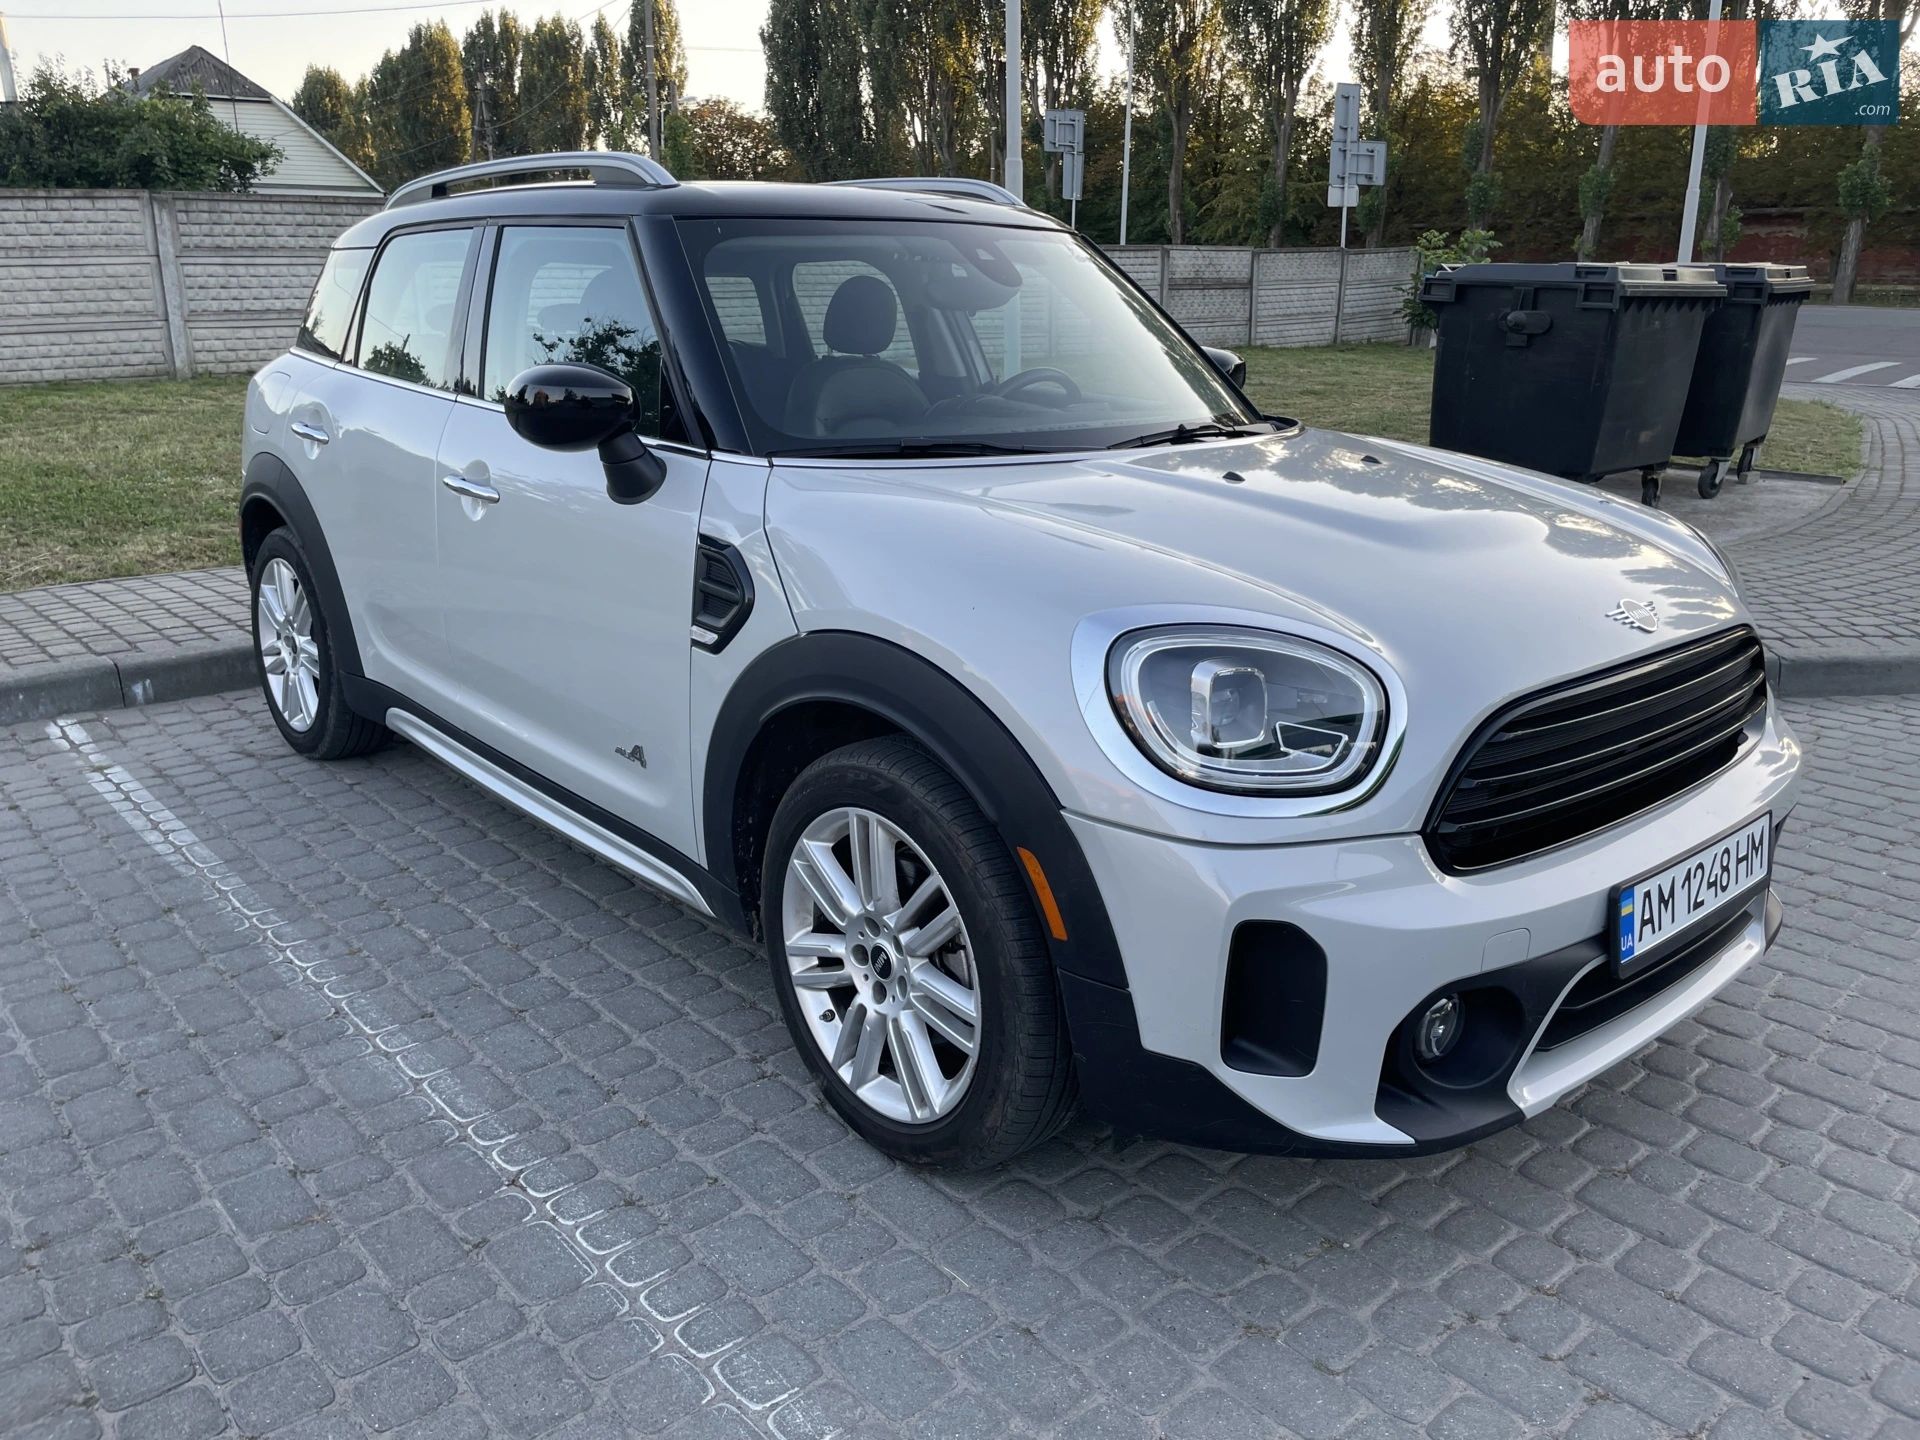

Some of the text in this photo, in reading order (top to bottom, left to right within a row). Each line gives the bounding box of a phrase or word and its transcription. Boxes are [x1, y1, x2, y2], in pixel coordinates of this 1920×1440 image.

[1638, 825, 1765, 943] AM 1248 HM
[1621, 932, 1633, 951] UA
[874, 951, 887, 973] MINI
